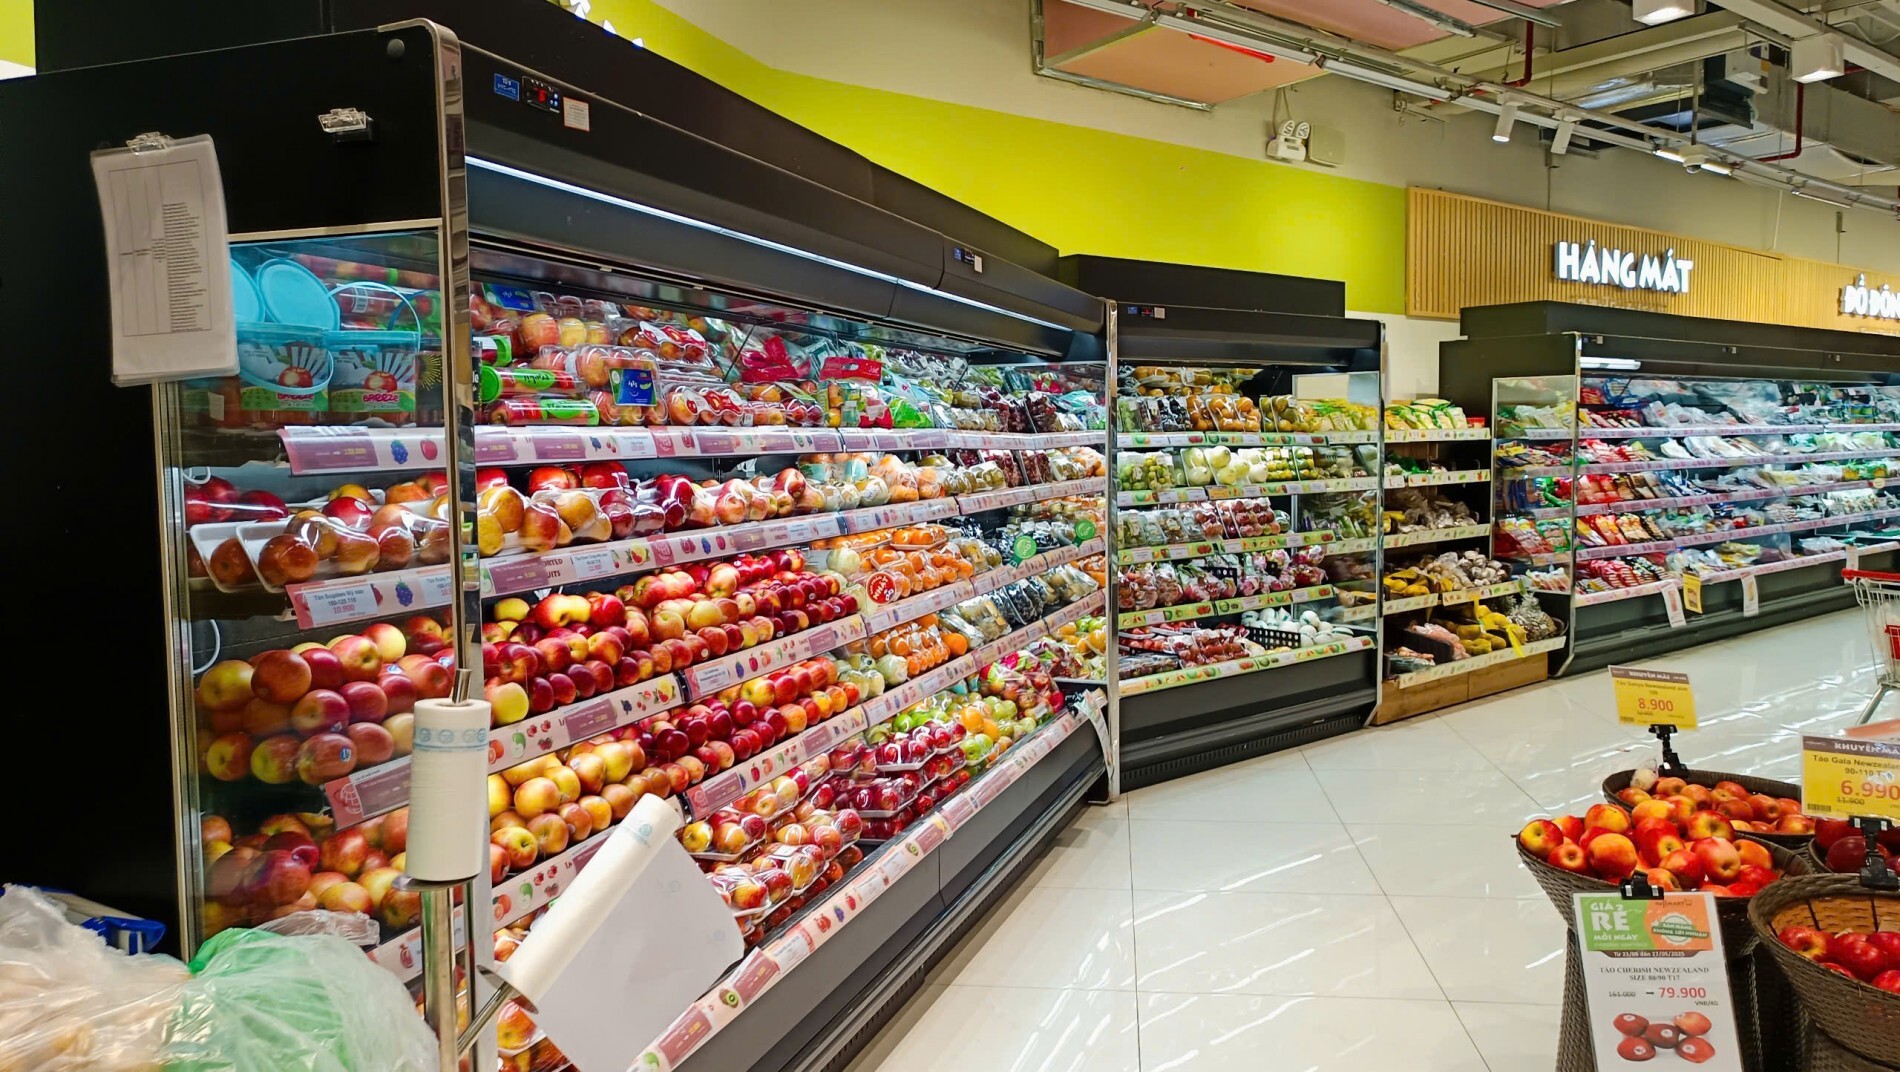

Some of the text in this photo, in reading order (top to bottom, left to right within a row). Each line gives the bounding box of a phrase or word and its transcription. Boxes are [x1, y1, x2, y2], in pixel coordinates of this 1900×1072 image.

[1638, 248, 1694, 293] MÁT
[1638, 697, 1674, 712] 8.900
[1831, 756, 1852, 765] Gala
[1590, 899, 1614, 911] GIÁ
[1658, 986, 1707, 999] 79.900
